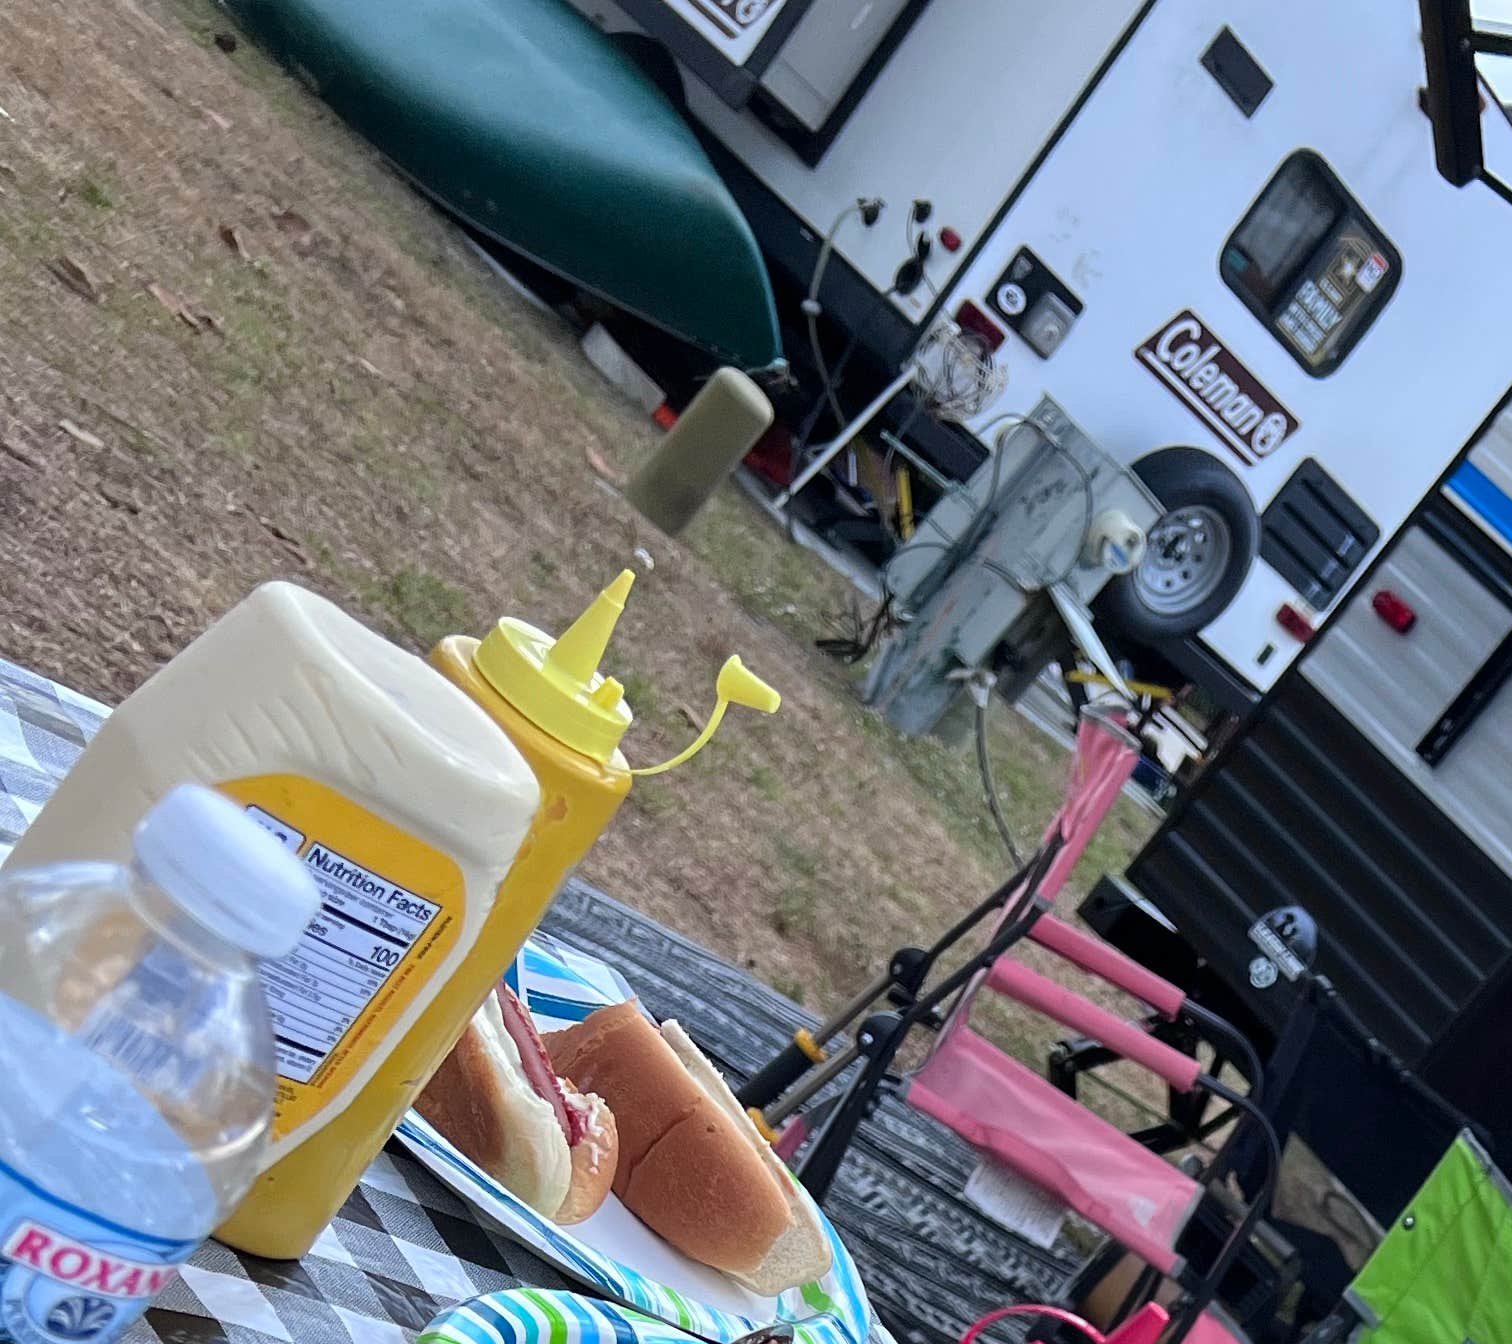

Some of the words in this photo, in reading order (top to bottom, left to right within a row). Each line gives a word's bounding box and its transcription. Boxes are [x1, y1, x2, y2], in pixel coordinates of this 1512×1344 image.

[1156, 319, 1264, 435] Coleman
[307, 848, 386, 900] Nutrition
[387, 889, 433, 922] Facts
[370, 945, 400, 967] 100
